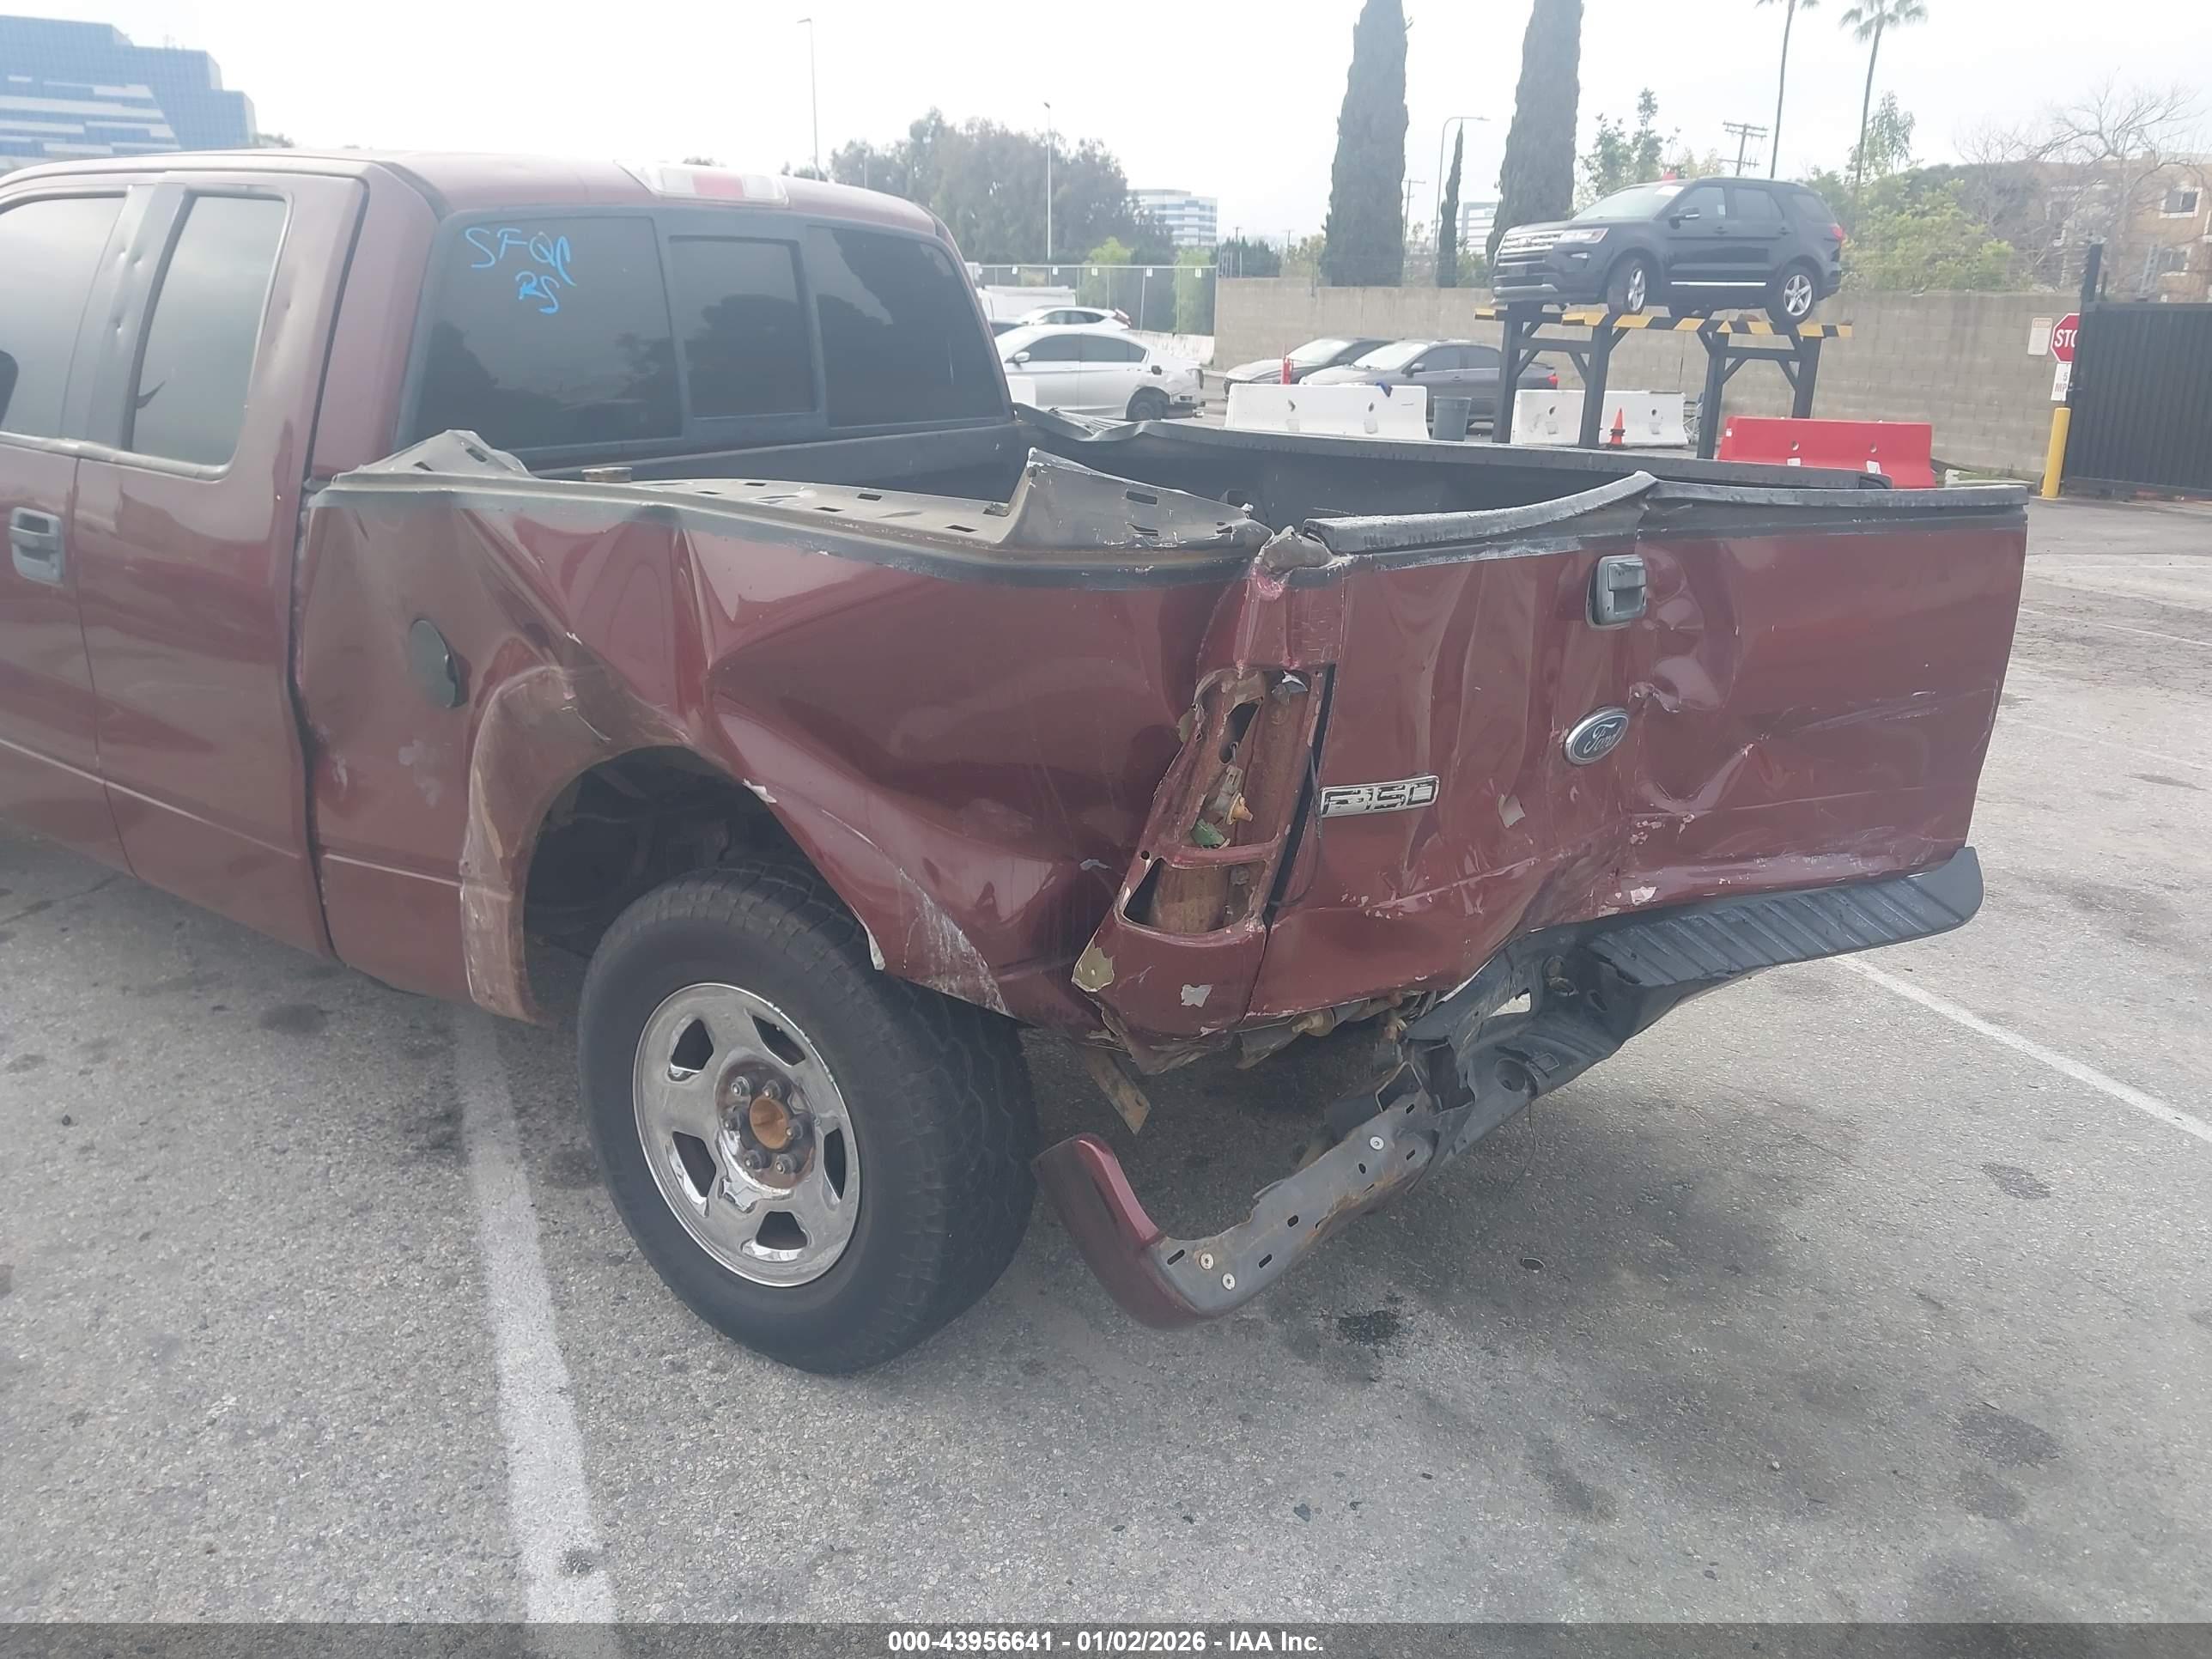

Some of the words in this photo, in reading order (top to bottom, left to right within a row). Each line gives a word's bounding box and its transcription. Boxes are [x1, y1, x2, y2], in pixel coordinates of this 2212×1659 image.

[2055, 329, 2077, 348] ST
[2055, 383, 2068, 392] MP
[1583, 721, 1622, 754] Ford
